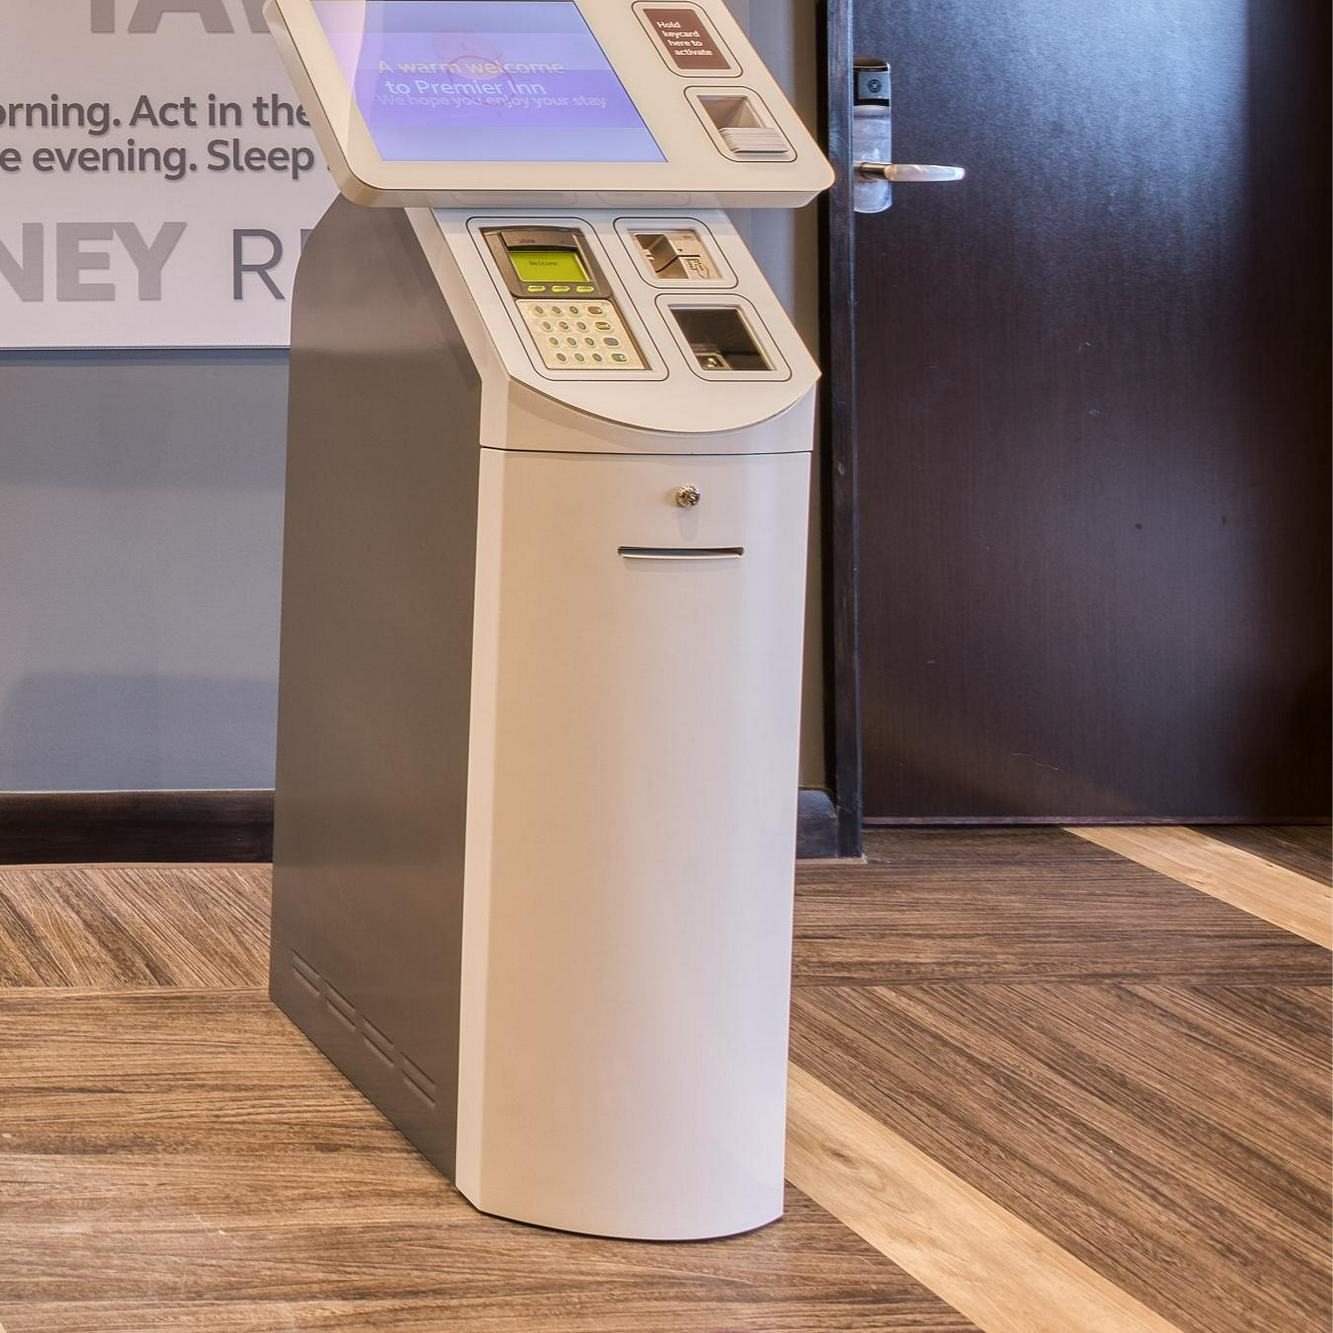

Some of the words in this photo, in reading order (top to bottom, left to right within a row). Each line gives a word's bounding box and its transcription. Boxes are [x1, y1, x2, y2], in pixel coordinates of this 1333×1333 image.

[378, 59, 395, 74] A
[398, 62, 459, 74] warm
[464, 59, 566, 74] welcome
[385, 80, 411, 95] to
[415, 79, 503, 95] Premier
[509, 79, 547, 95] Inn
[451, 96, 484, 108] you
[485, 94, 531, 110] enjoy
[531, 96, 569, 109] your
[573, 95, 607, 109] stay
[129, 94, 199, 128] Act
[209, 94, 243, 127] in
[253, 94, 311, 126] the
[32, 140, 196, 179] evening.
[207, 138, 315, 180] Sleep
